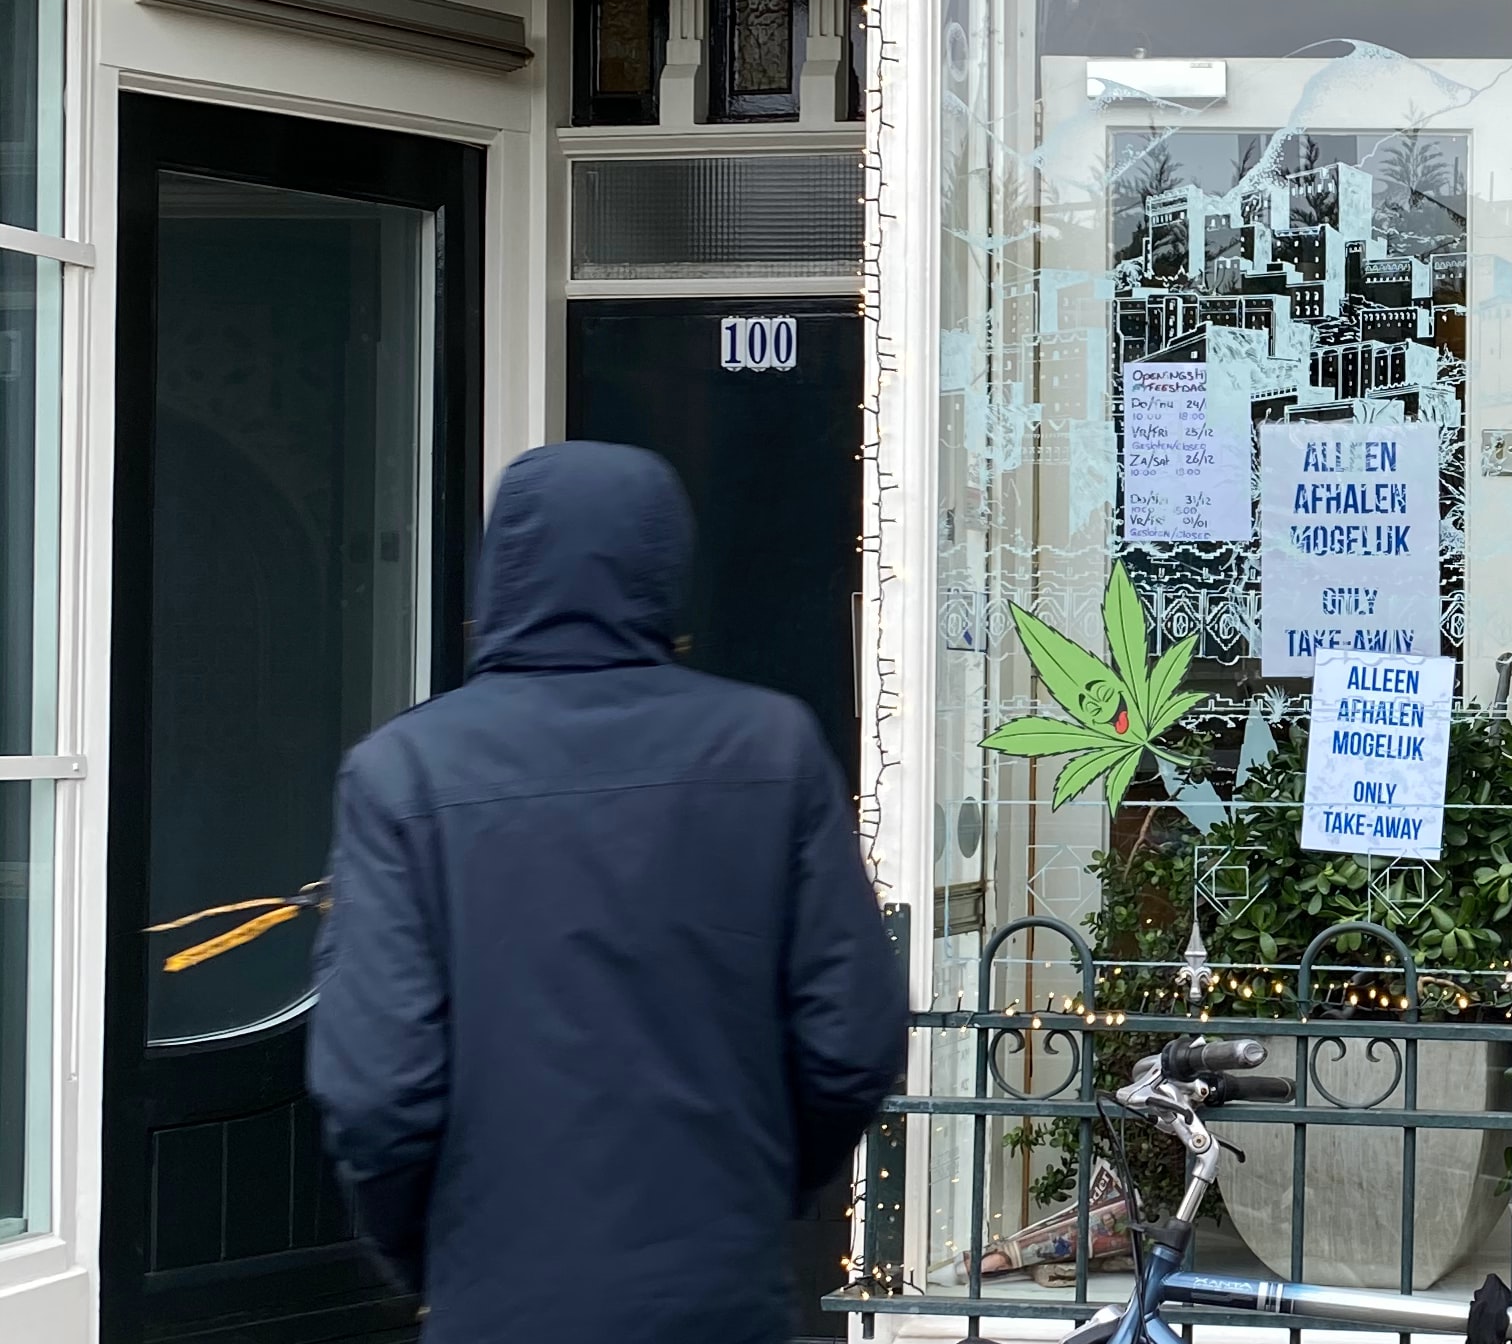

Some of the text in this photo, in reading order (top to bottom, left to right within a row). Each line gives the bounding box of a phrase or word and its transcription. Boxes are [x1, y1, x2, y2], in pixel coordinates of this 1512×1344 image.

[725, 321, 793, 364] 100
[1186, 449, 1215, 465] 26/12
[1293, 483, 1407, 514] AFHALEN
[1290, 525, 1411, 556] MOGELIJK
[1322, 587, 1378, 616] ONLY
[1347, 665, 1420, 694] ALLEEN
[1337, 697, 1424, 728] AFHALEN
[1332, 730, 1425, 761] MOGELIJK
[1353, 780, 1397, 804] ONLY
[1323, 811, 1423, 840] TAKE-AWAY
